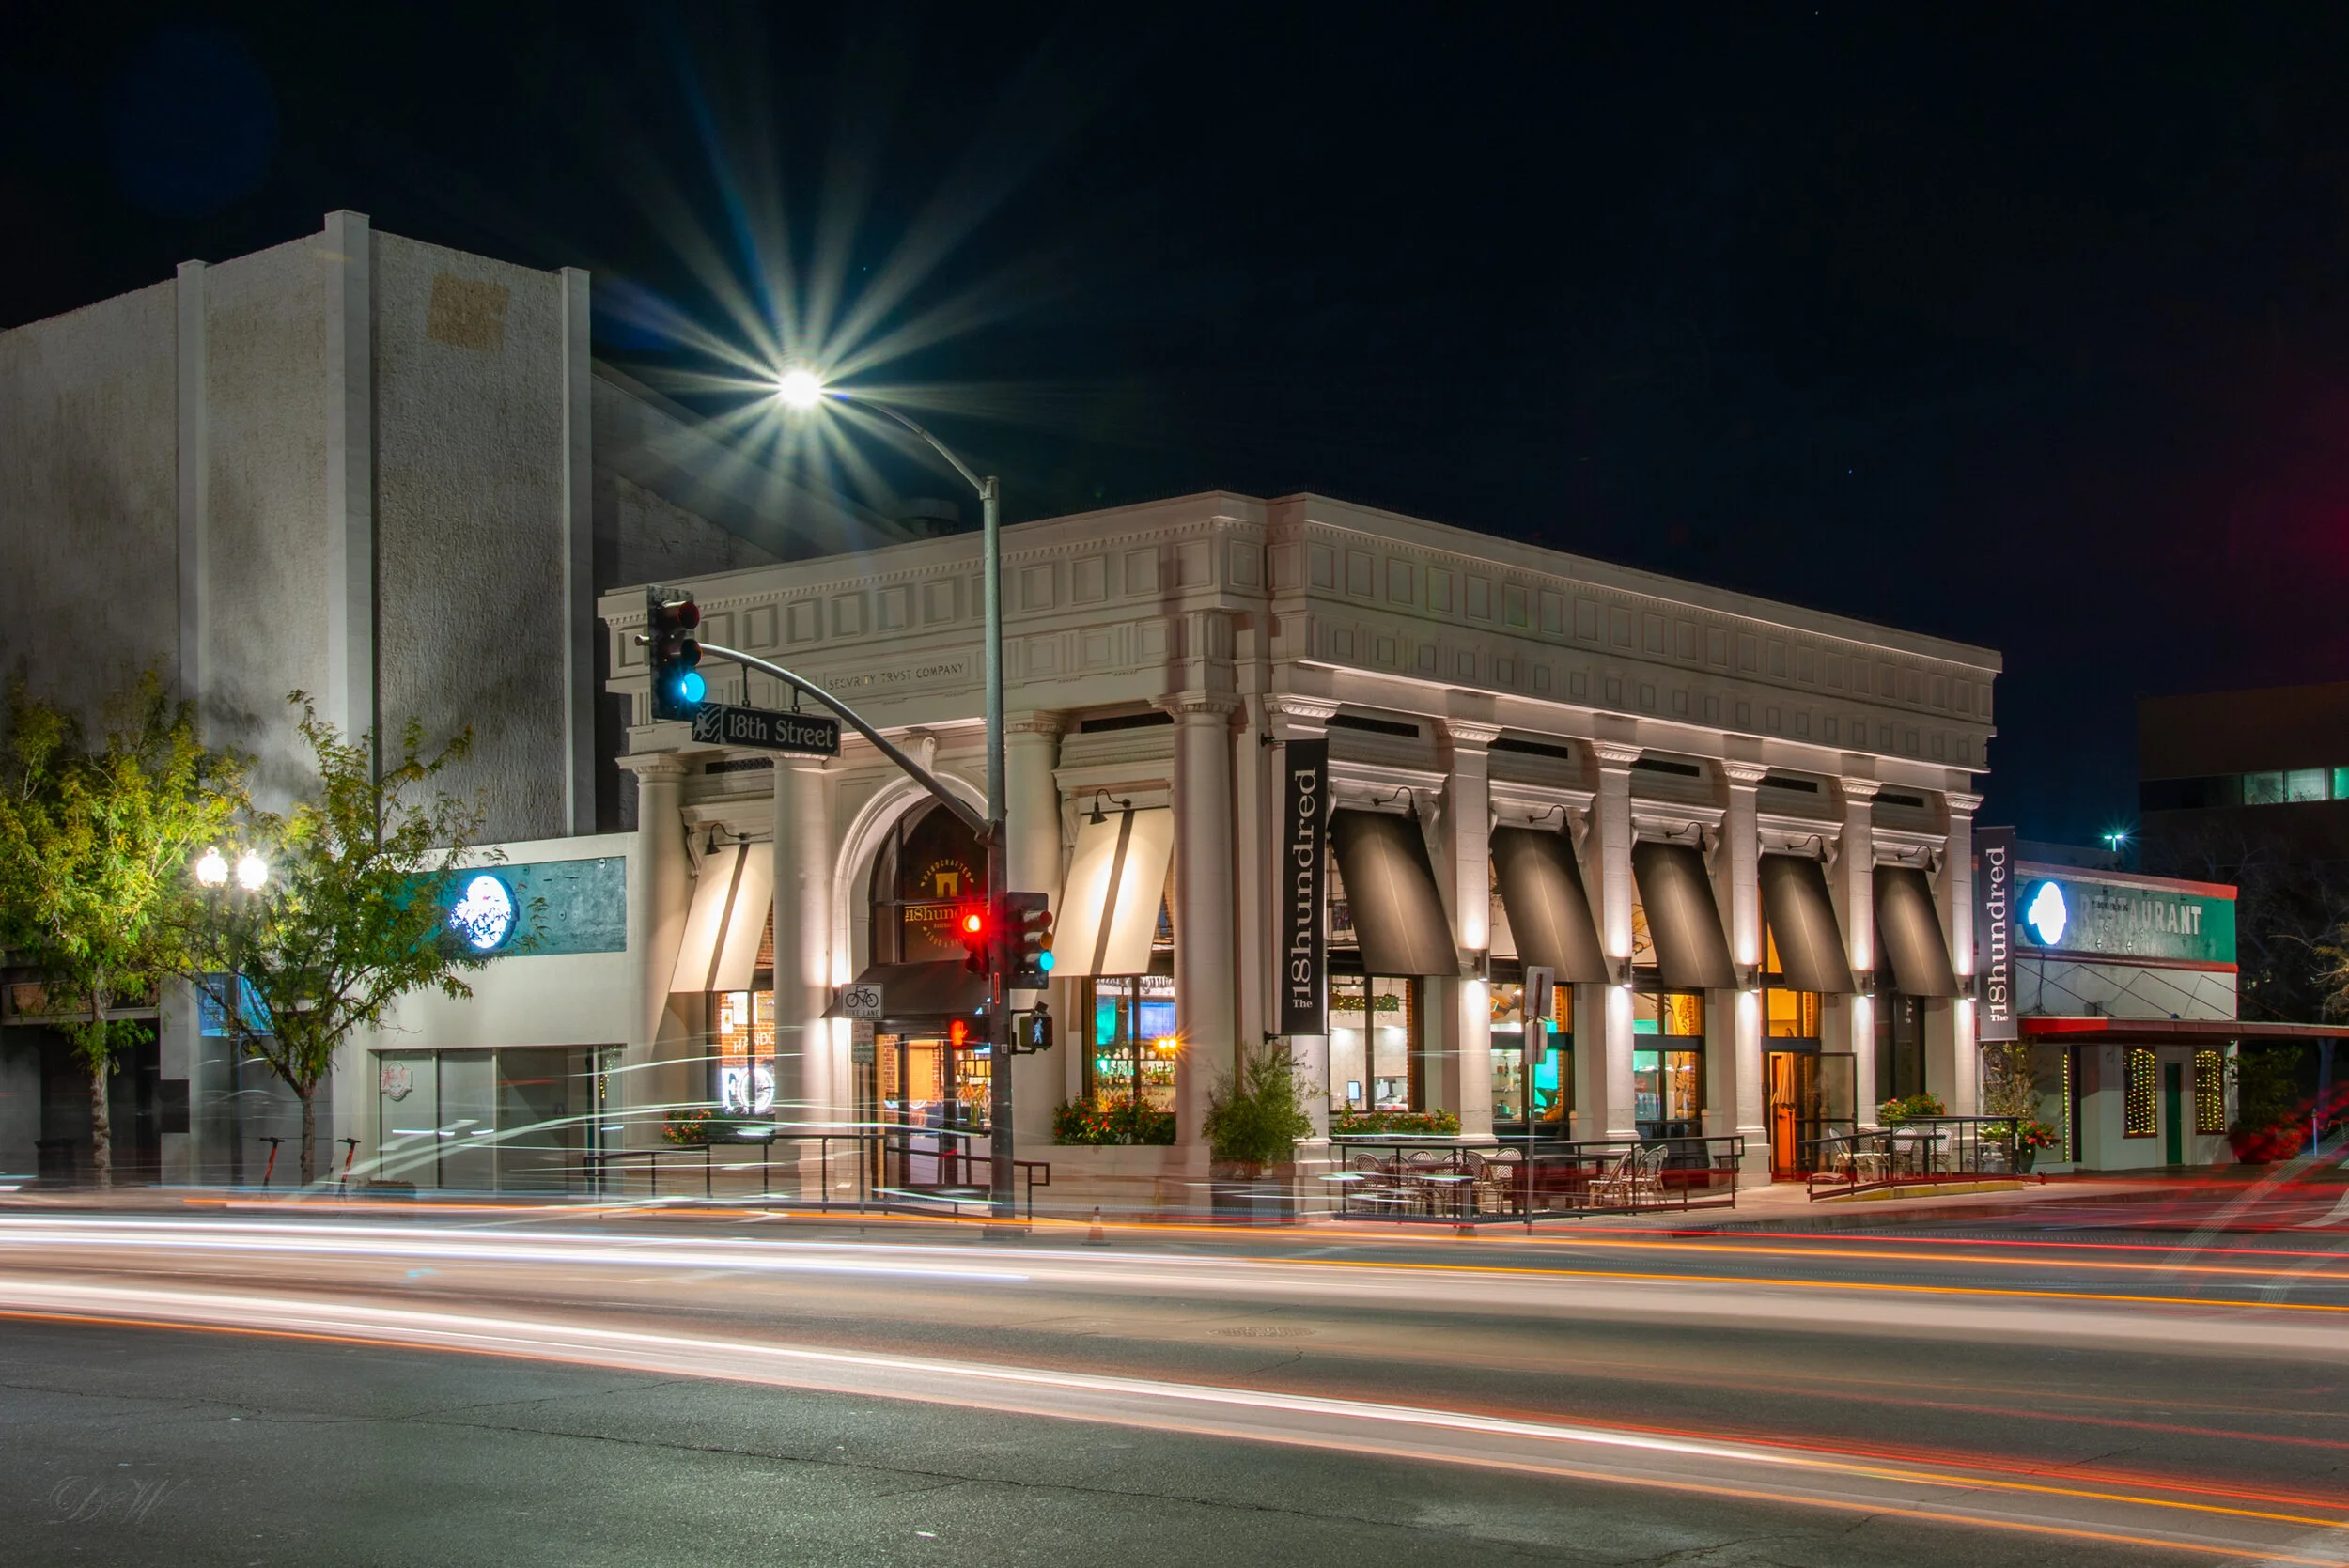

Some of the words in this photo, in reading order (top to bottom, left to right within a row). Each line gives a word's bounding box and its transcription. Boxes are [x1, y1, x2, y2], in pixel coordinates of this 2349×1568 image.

[916, 662, 964, 679] COMPANY
[728, 713, 768, 741] 18th
[775, 719, 834, 748] Street
[1290, 767, 1315, 998] 18hundred
[909, 906, 986, 922] 18hund
[1985, 846, 2008, 1014] 18hundred
[1293, 999, 1313, 1008] The
[1990, 1014, 2009, 1022] The
